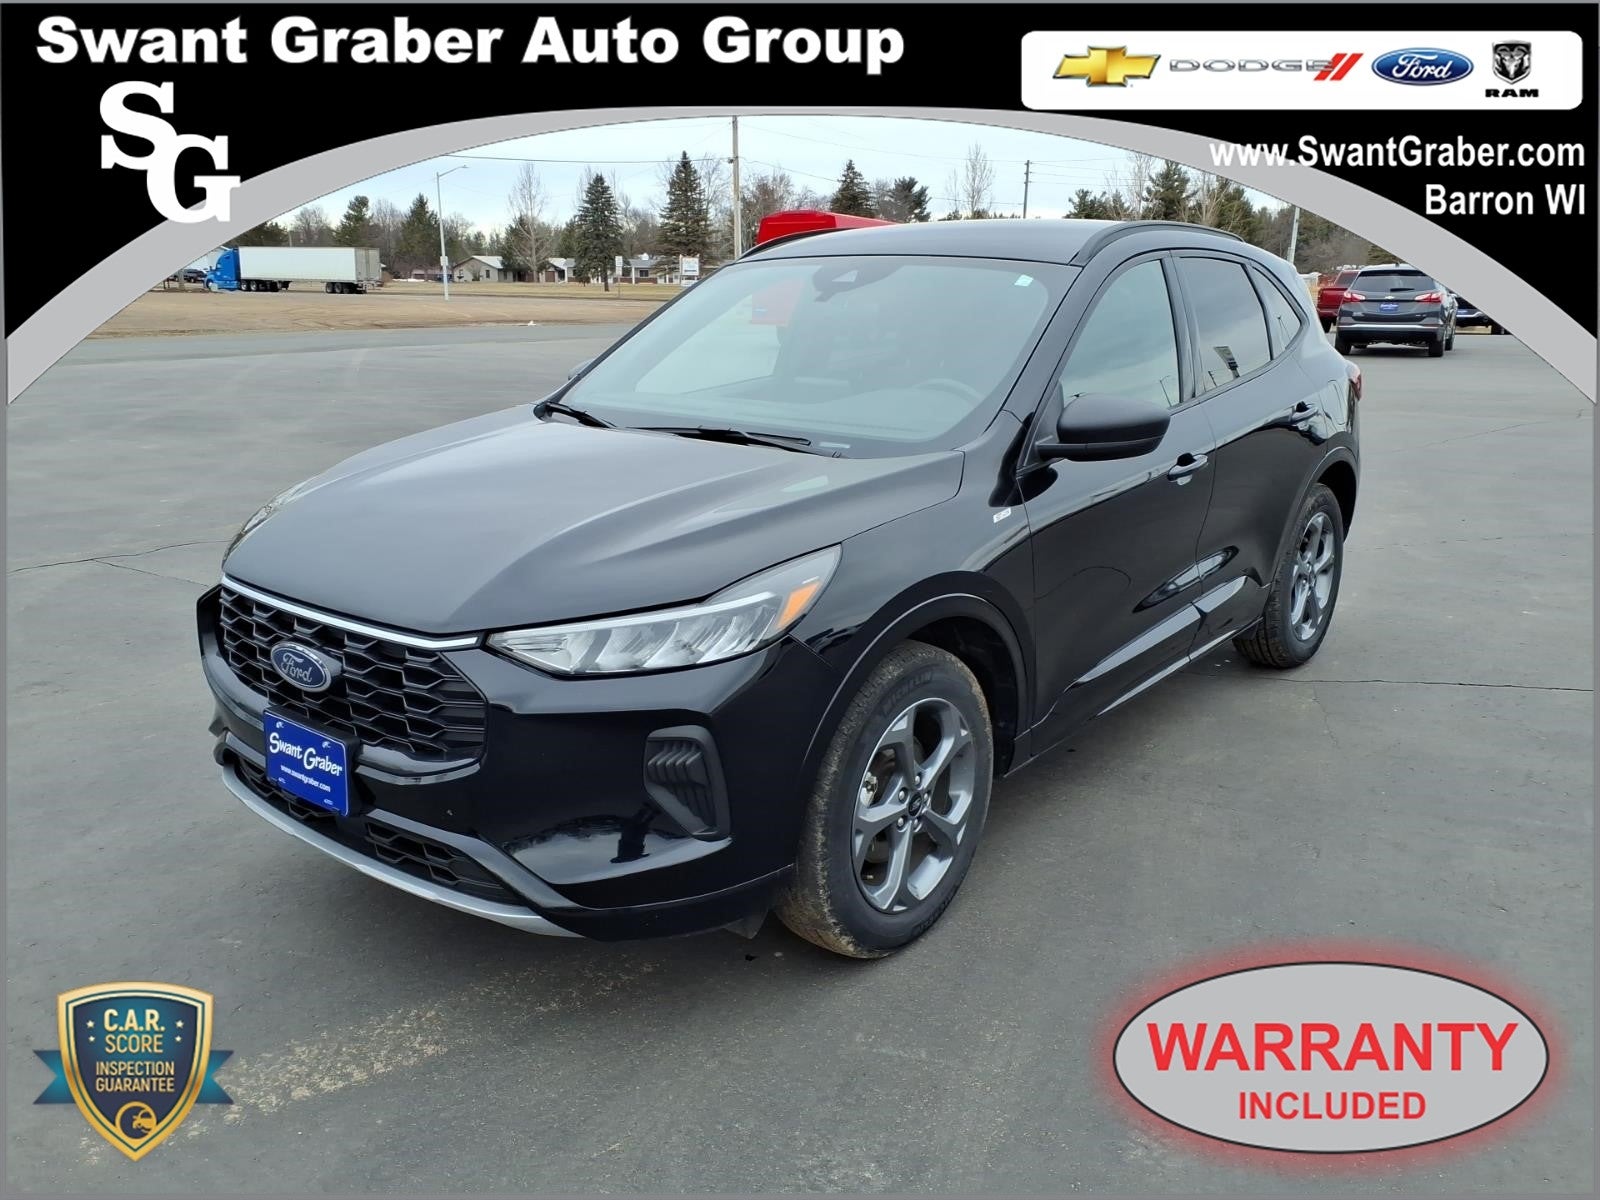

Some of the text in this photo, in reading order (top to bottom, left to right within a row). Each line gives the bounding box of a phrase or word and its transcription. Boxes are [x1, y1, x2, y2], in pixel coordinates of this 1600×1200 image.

[281, 652, 313, 683] Ford
[269, 732, 343, 777] Swant Graber
